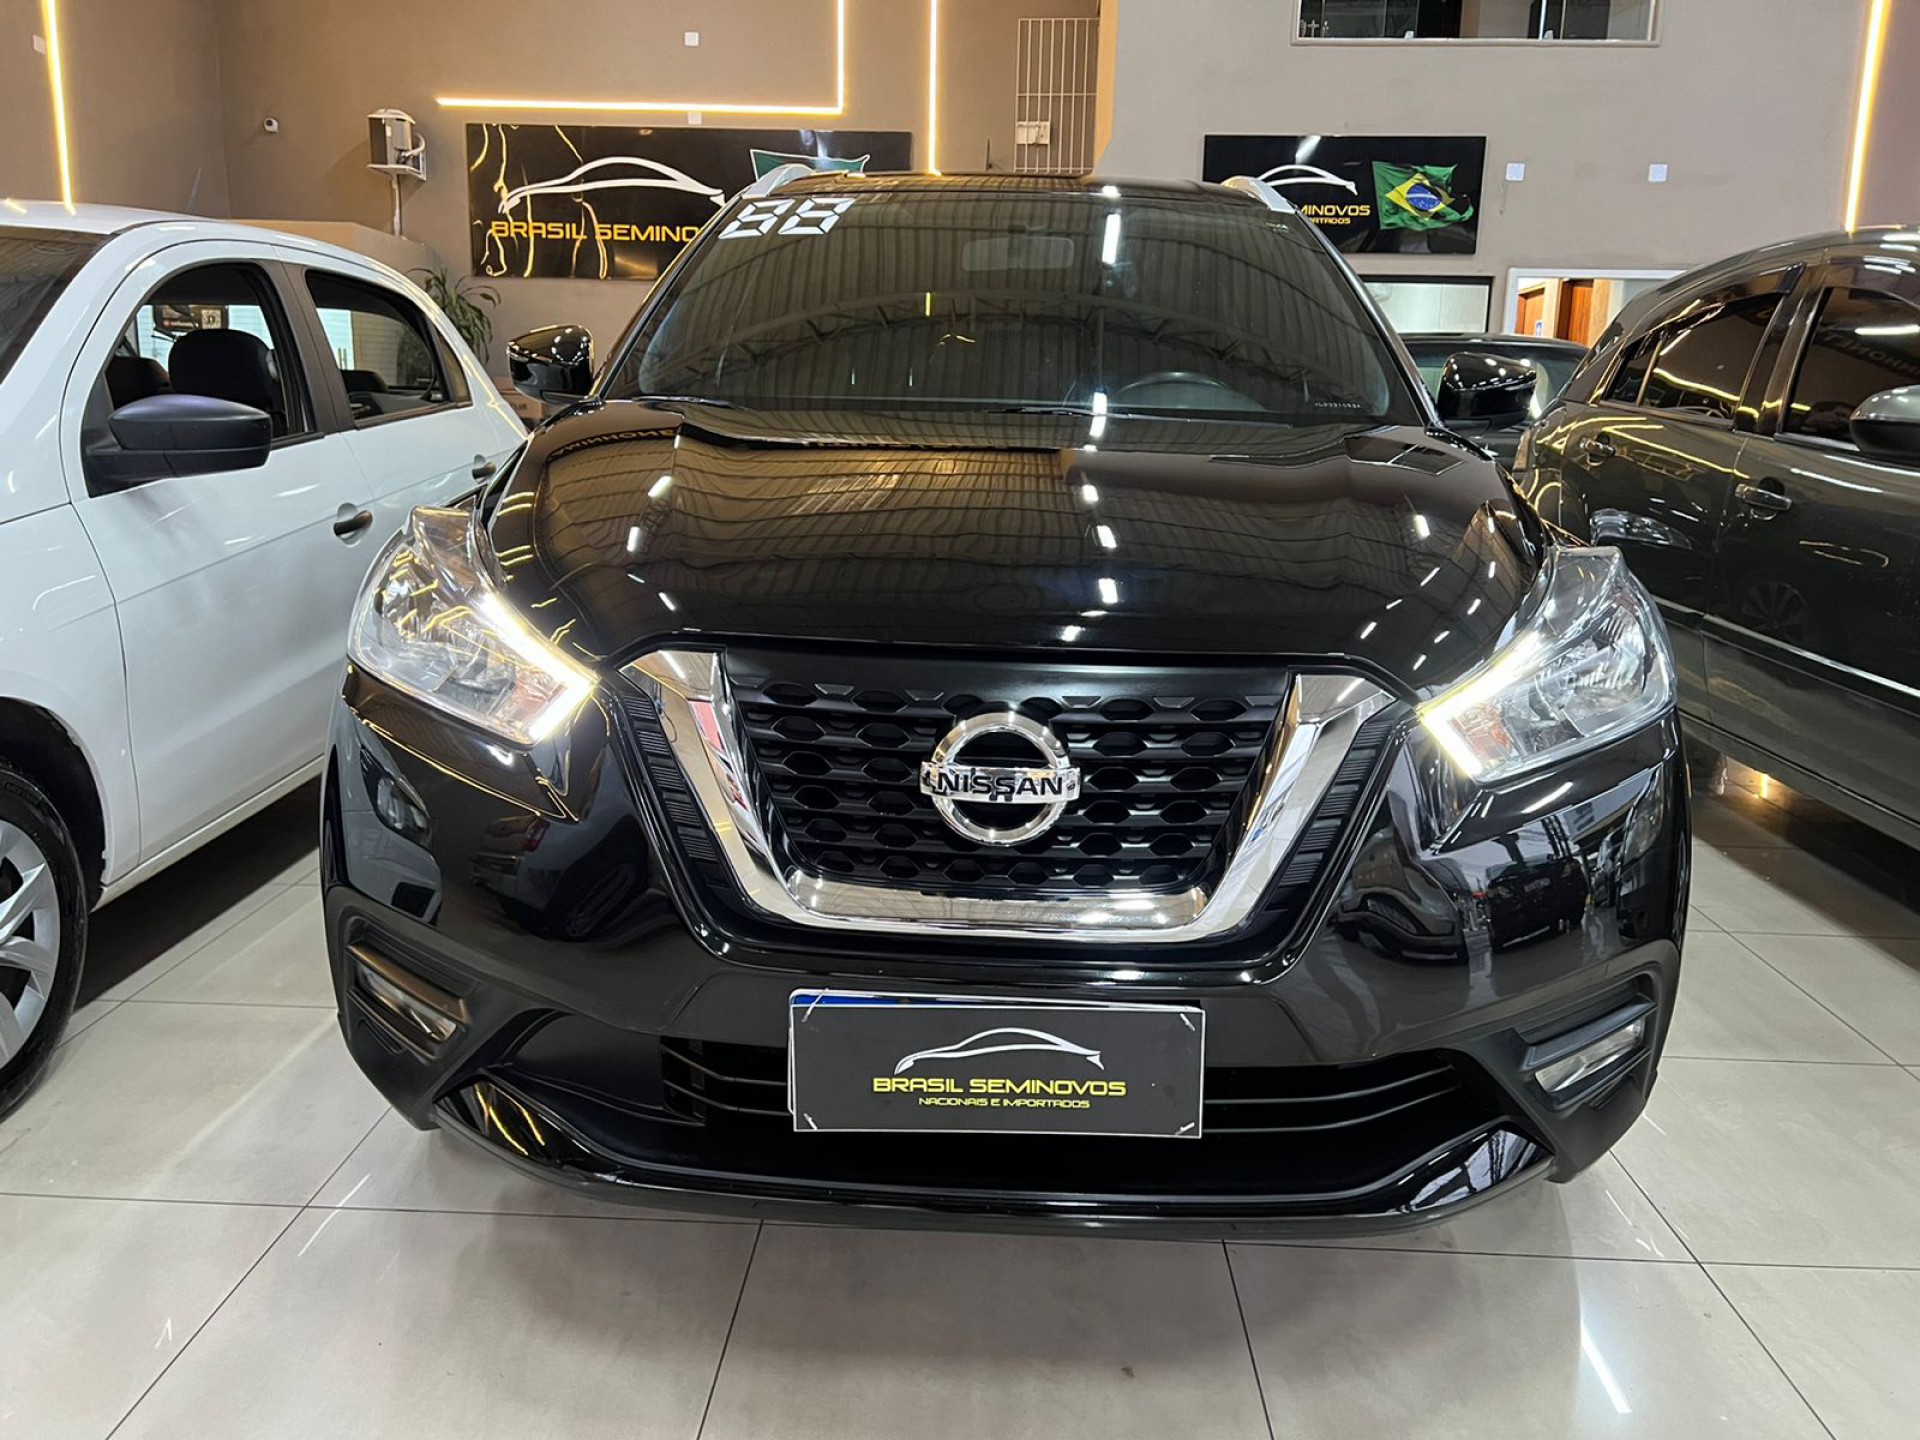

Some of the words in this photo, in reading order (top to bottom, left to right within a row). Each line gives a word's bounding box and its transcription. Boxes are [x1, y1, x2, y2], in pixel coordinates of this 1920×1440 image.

[491, 220, 588, 240] BRASIL
[937, 772, 1063, 796] NISSAN
[873, 1078, 964, 1093] BRASIL
[969, 1078, 1127, 1096] SEMINOVOS
[918, 1097, 988, 1107] NACIONAIS
[990, 1098, 1000, 1106] E
[1003, 1098, 1091, 1109] IMPORTADOS
